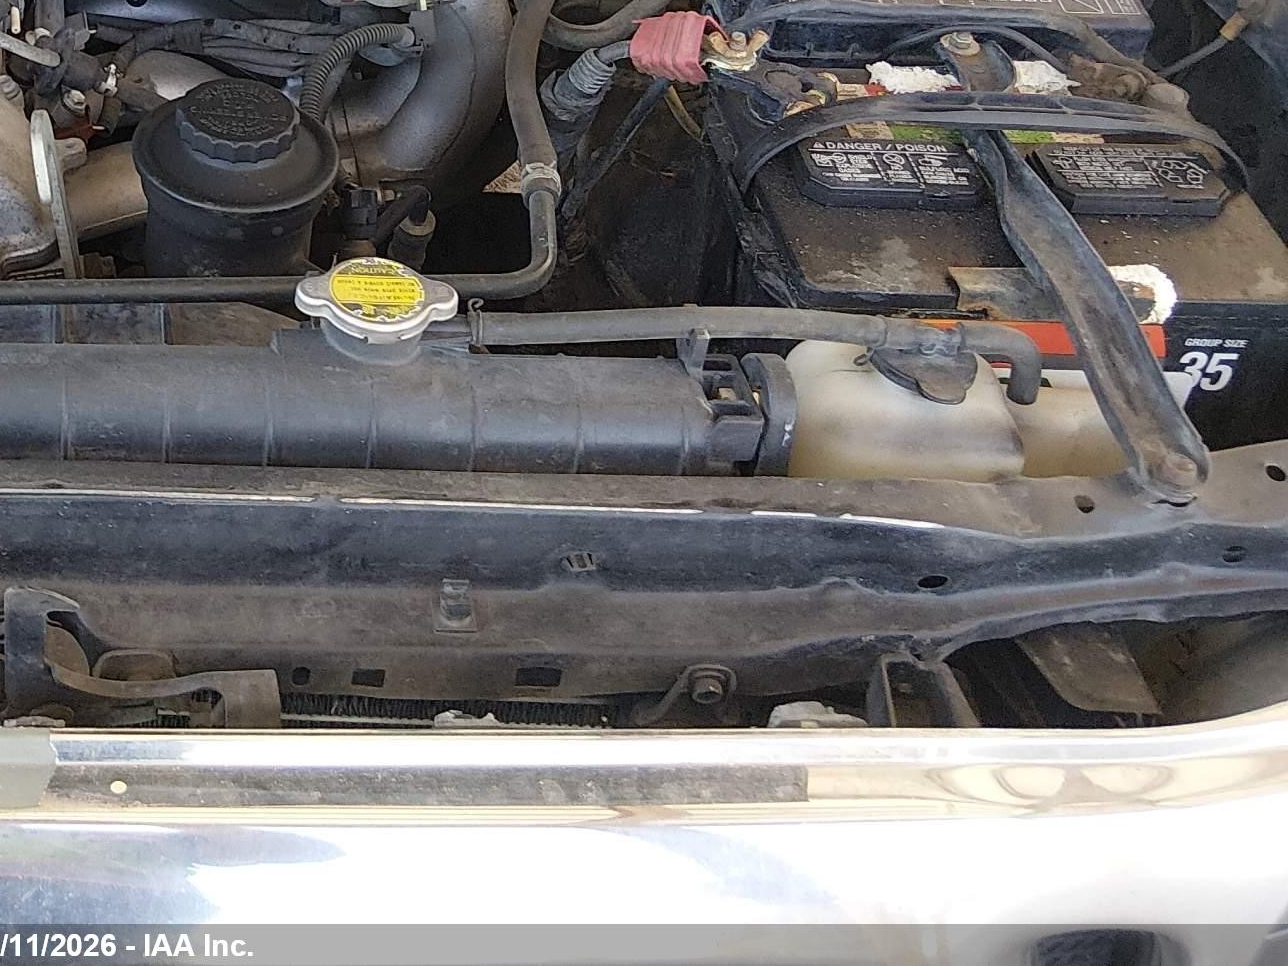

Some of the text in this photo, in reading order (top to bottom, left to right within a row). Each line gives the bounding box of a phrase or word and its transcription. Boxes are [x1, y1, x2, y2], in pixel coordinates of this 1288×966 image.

[824, 141, 882, 151] DANGER
[896, 143, 947, 153] POISON
[351, 265, 397, 276] CAUTION
[1184, 338, 1249, 348] GROUP SIZE
[1179, 351, 1240, 391] 35
